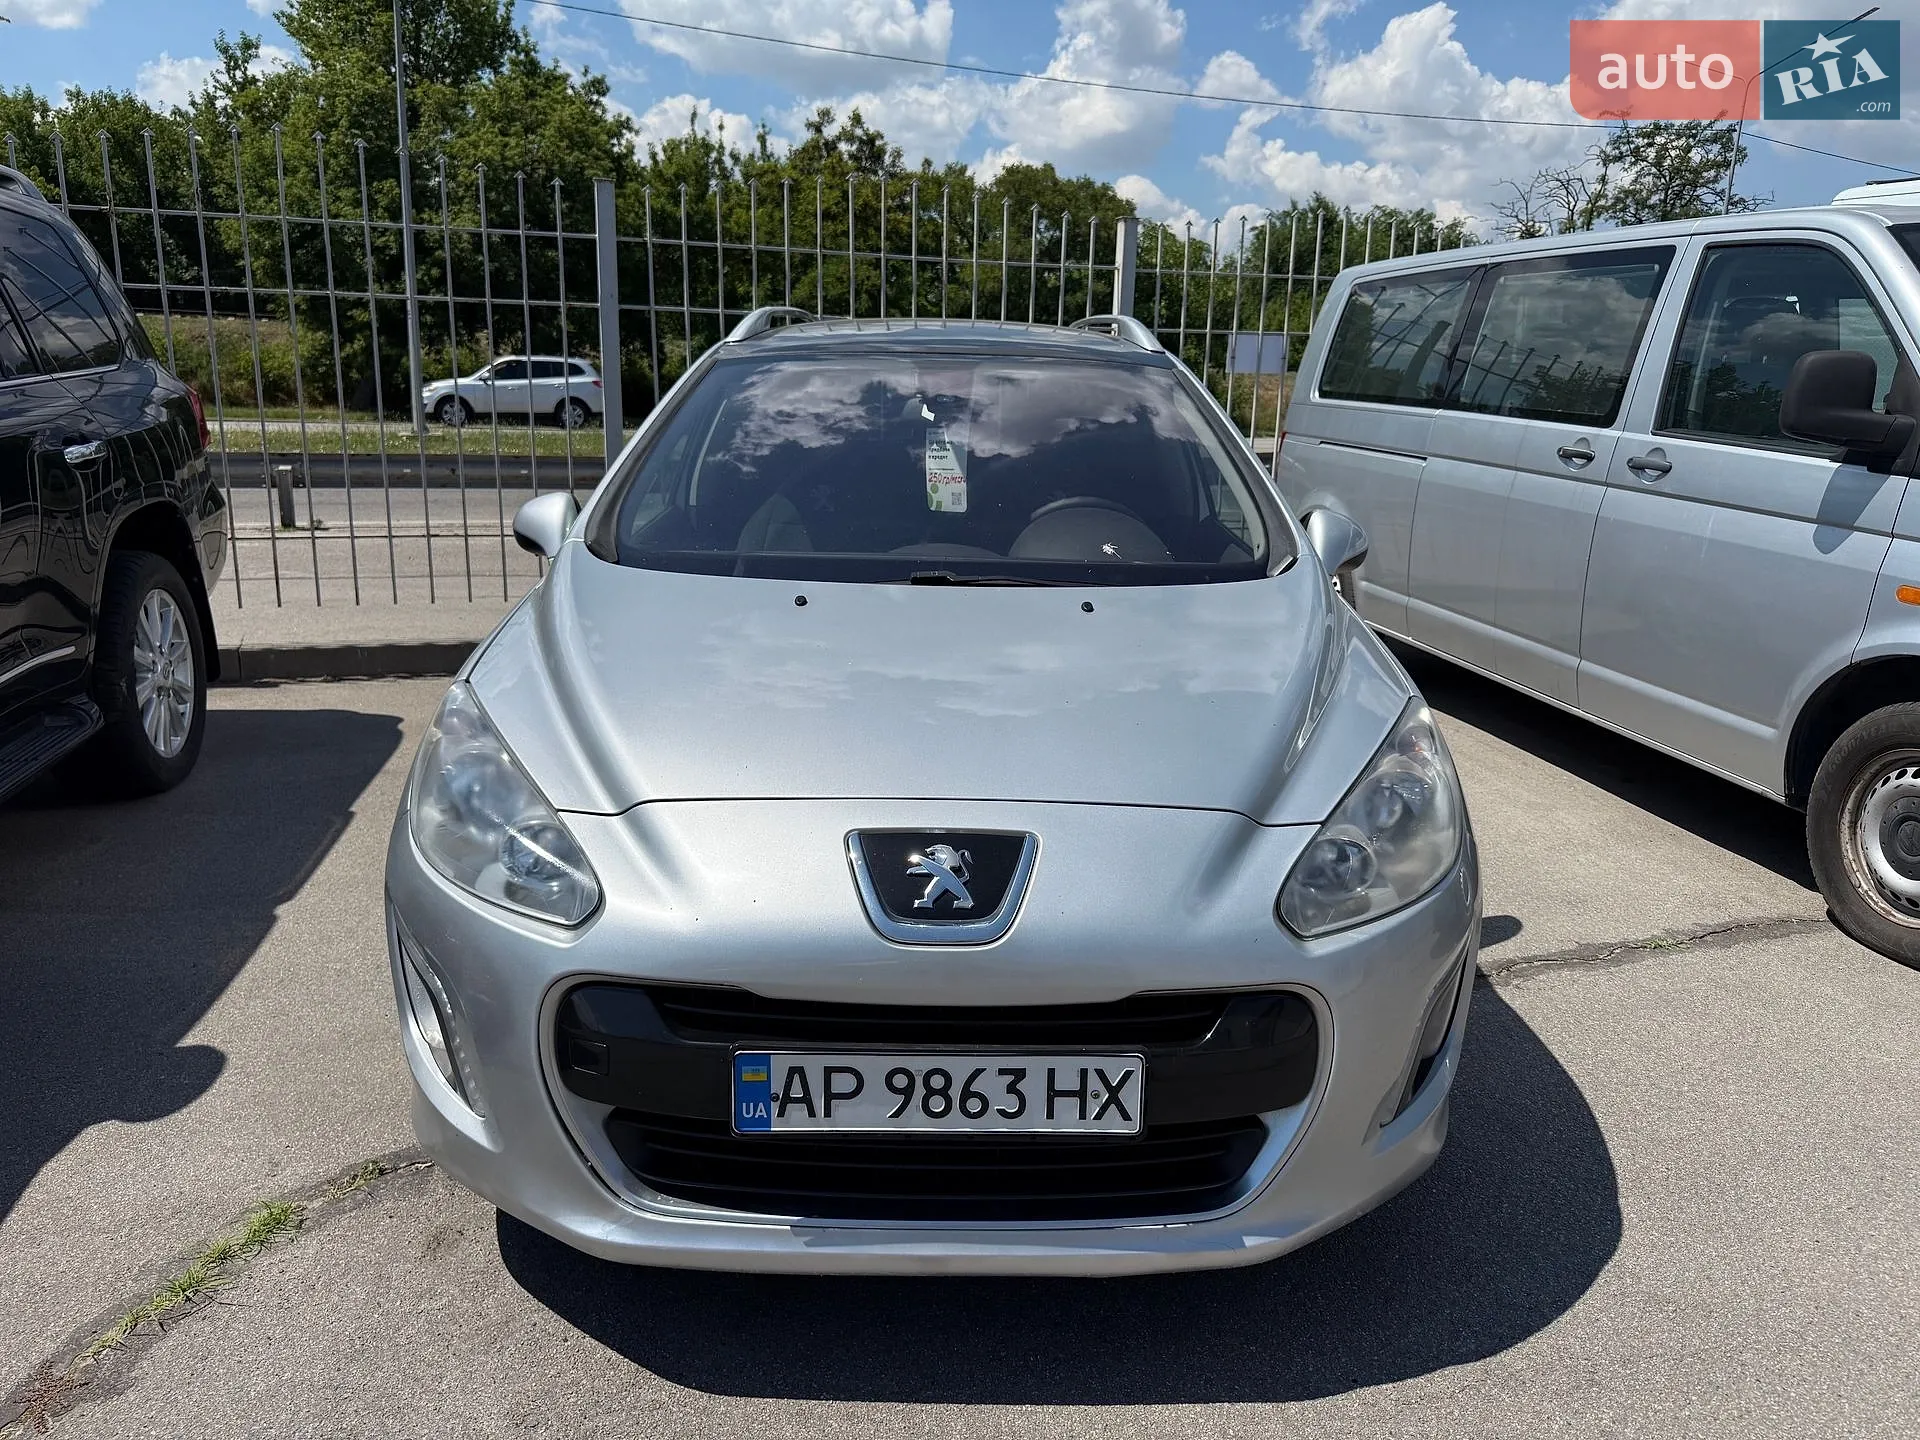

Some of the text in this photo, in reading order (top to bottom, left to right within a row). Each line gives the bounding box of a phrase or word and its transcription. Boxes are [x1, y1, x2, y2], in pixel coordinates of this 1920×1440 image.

[742, 1103, 767, 1118] UA
[775, 1065, 1135, 1121] AP 9863 HX
